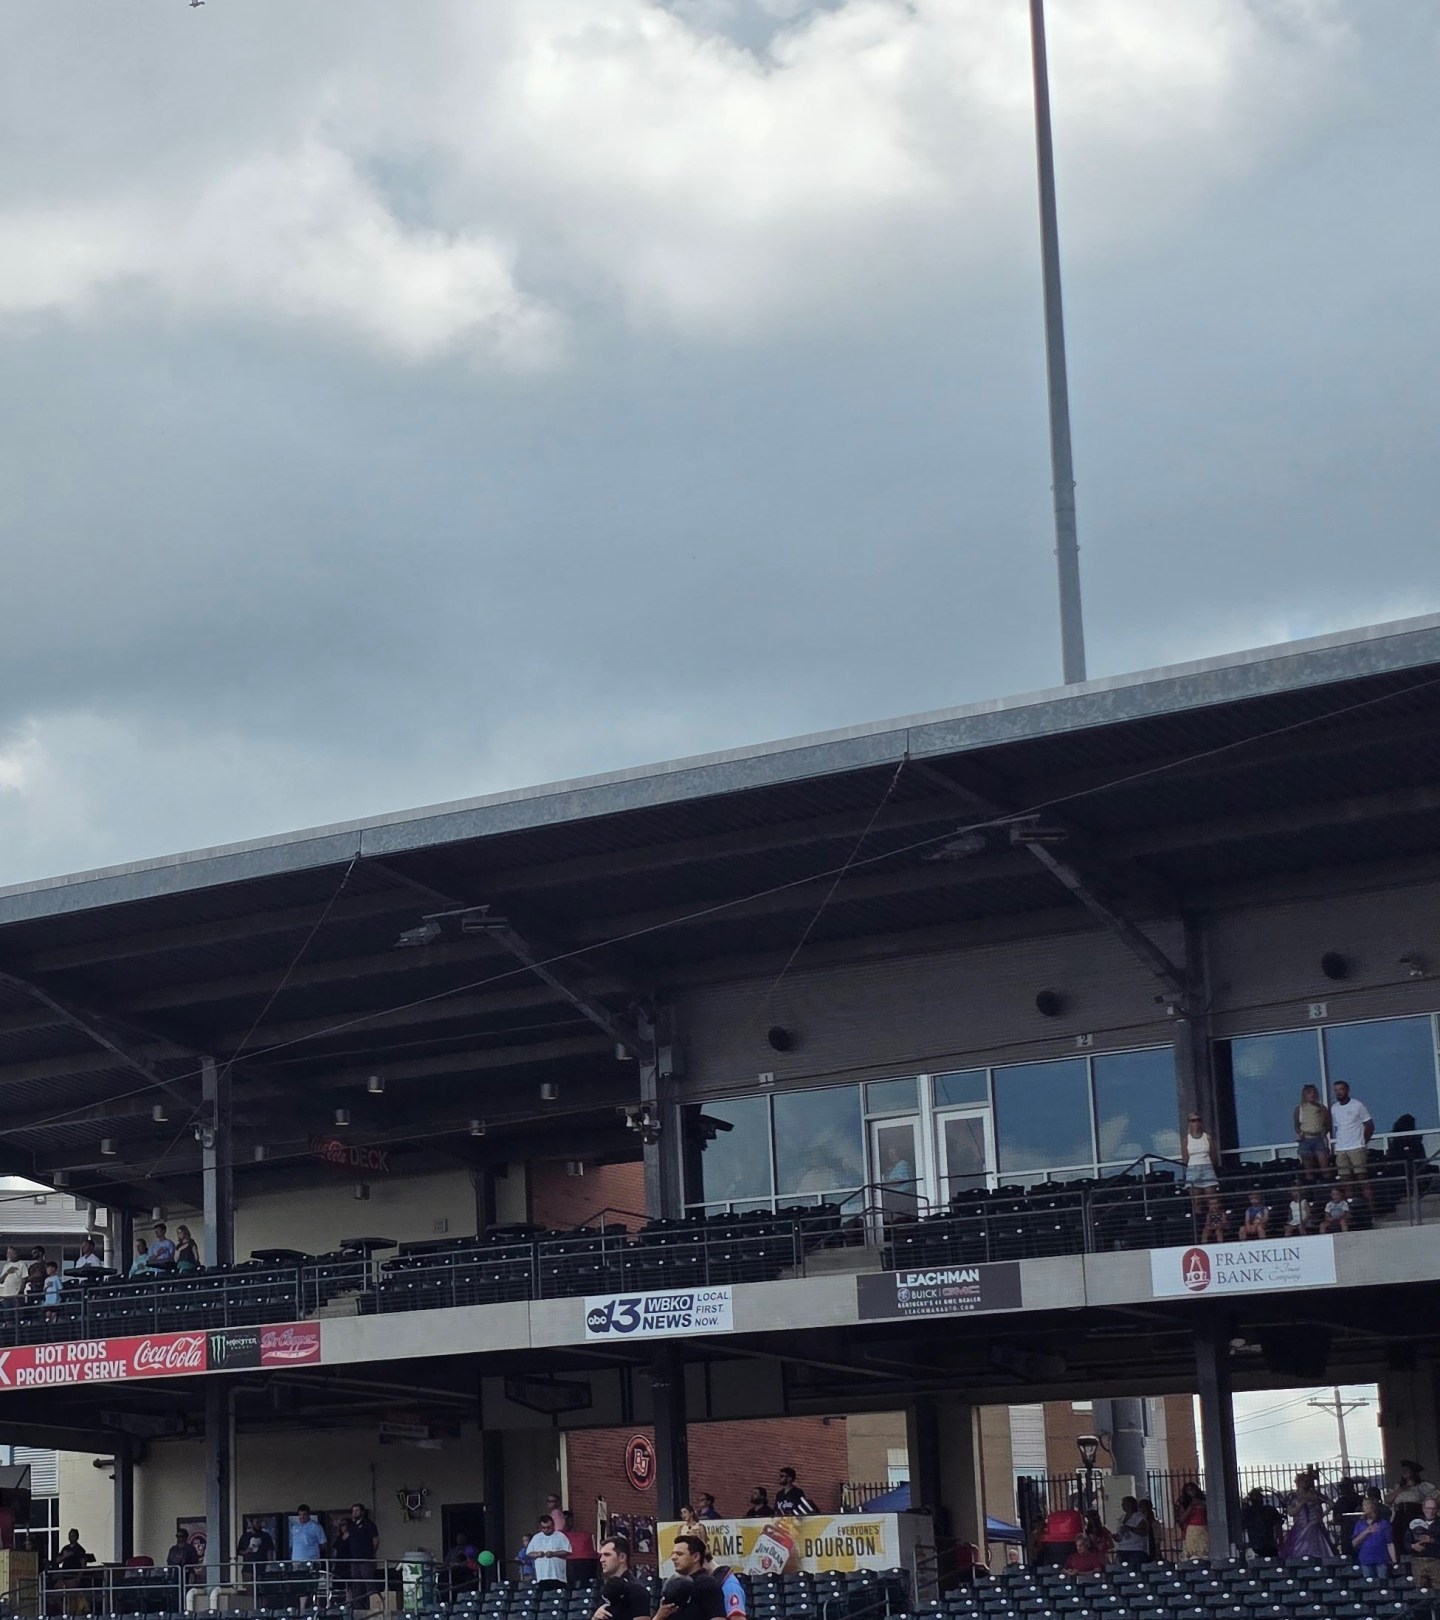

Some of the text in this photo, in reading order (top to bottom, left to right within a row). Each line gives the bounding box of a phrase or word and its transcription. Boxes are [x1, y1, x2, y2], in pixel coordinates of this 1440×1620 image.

[349, 1146, 390, 1173] DECK
[1215, 1247, 1300, 1266] FRANKLIN
[895, 1269, 980, 1288] LEACHMAN
[1217, 1268, 1263, 1284] BANK
[911, 1285, 980, 1300] BUICK GMC
[647, 1295, 690, 1312] WBKO
[587, 1298, 642, 1333] abc 13
[642, 1314, 692, 1330] NEWS
[694, 1317, 719, 1327] NOW.
[35, 1341, 107, 1364] HOT RODS
[133, 1335, 205, 1371] Coca-Cola
[16, 1360, 127, 1385] PROUDLY SERVE
[837, 1524, 881, 1536] EVERYONE'S
[707, 1535, 744, 1556] AME
[804, 1536, 876, 1557] BOURBON
